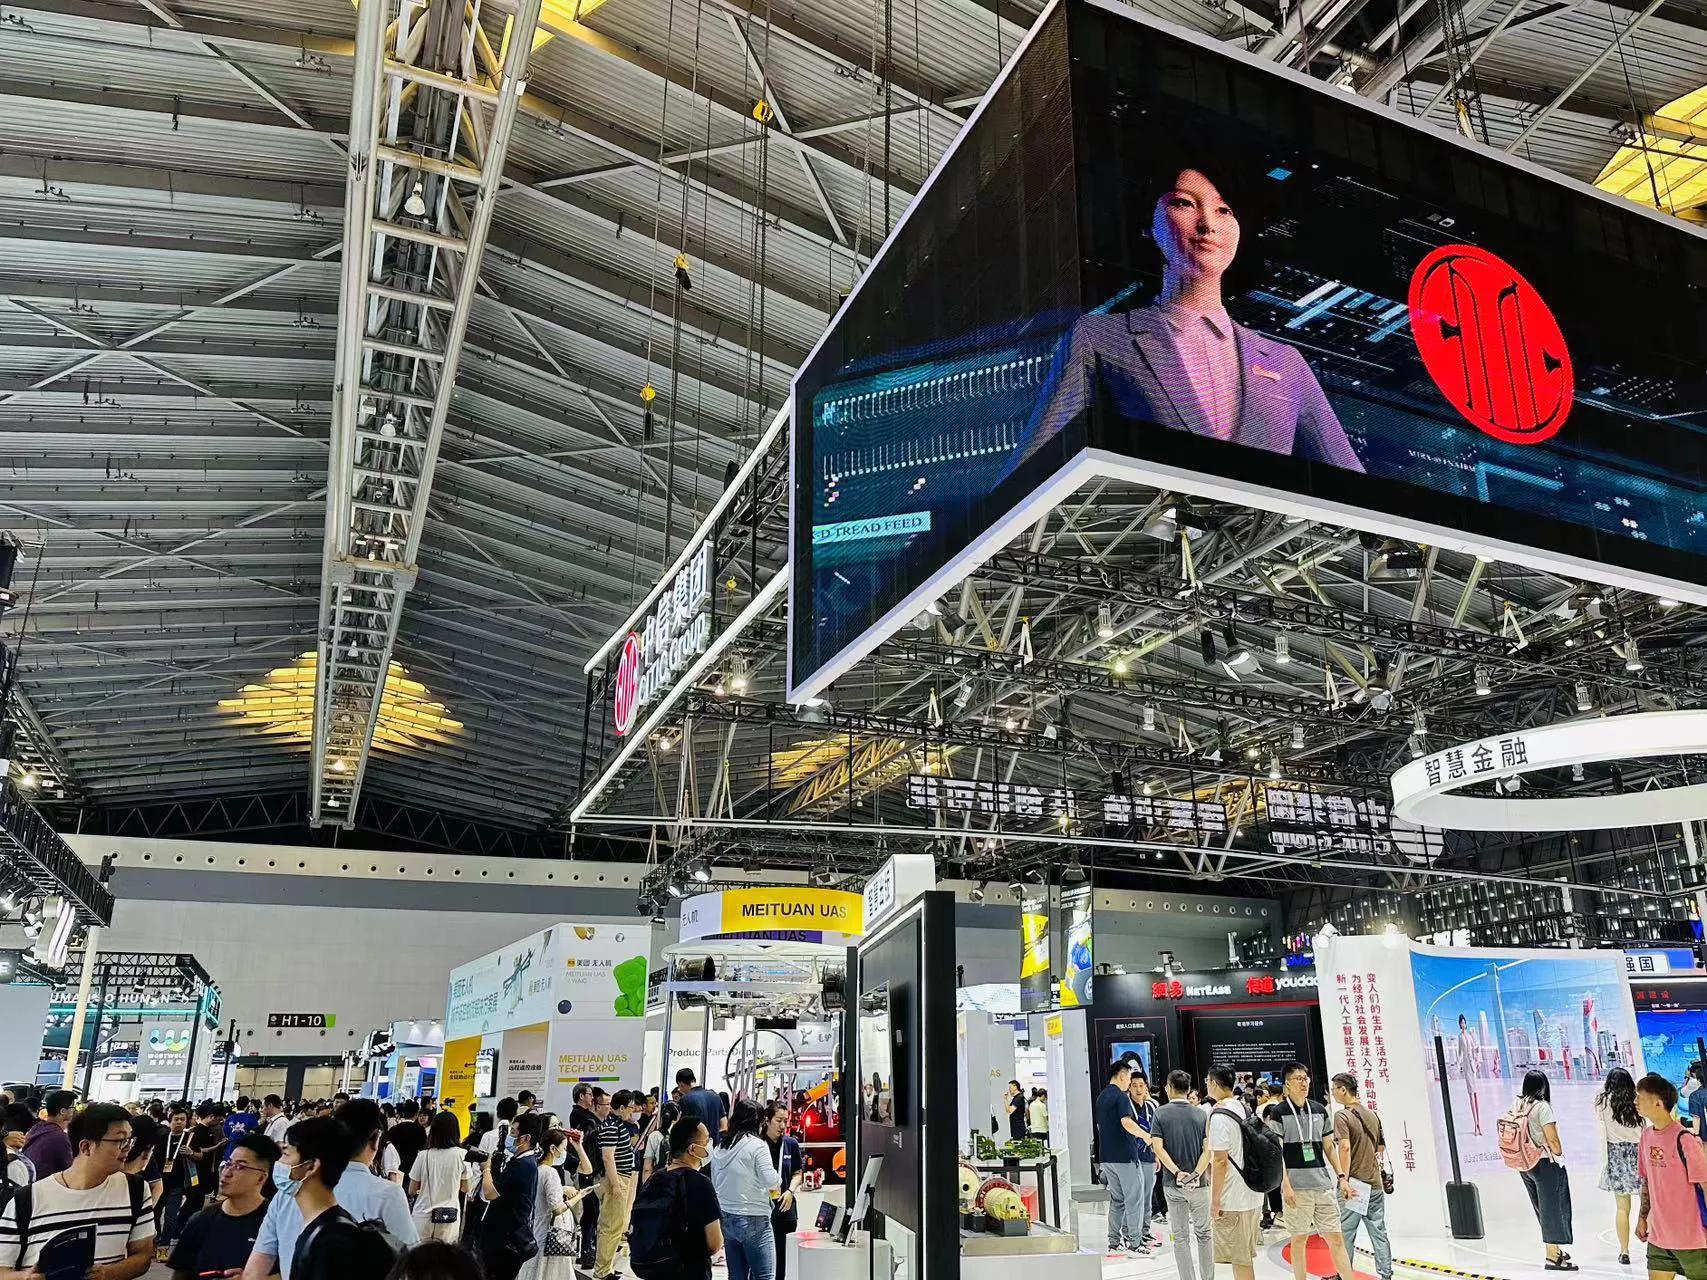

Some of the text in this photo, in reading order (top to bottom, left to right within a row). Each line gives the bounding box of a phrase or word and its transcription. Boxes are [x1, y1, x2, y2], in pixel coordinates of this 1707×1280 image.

[836, 523, 881, 537] TREAD
[885, 517, 923, 531] FEED
[640, 540, 713, 668] 中信集团
[639, 612, 711, 706] CITIC Group
[1423, 738, 1529, 787] 智慧金融
[742, 903, 847, 918] MEITUAN UAS
[1246, 975, 1277, 996] 有道
[281, 1015, 322, 1027] H1-10
[1366, 973, 1390, 1084] 变人们的生产生活方式。
[668, 1048, 702, 1057] Produc
[1352, 974, 1378, 1112] 为经济社会发展注入了新动能
[559, 1054, 628, 1063] MEITUAN UAS
[559, 1064, 616, 1073] TECH EXPO
